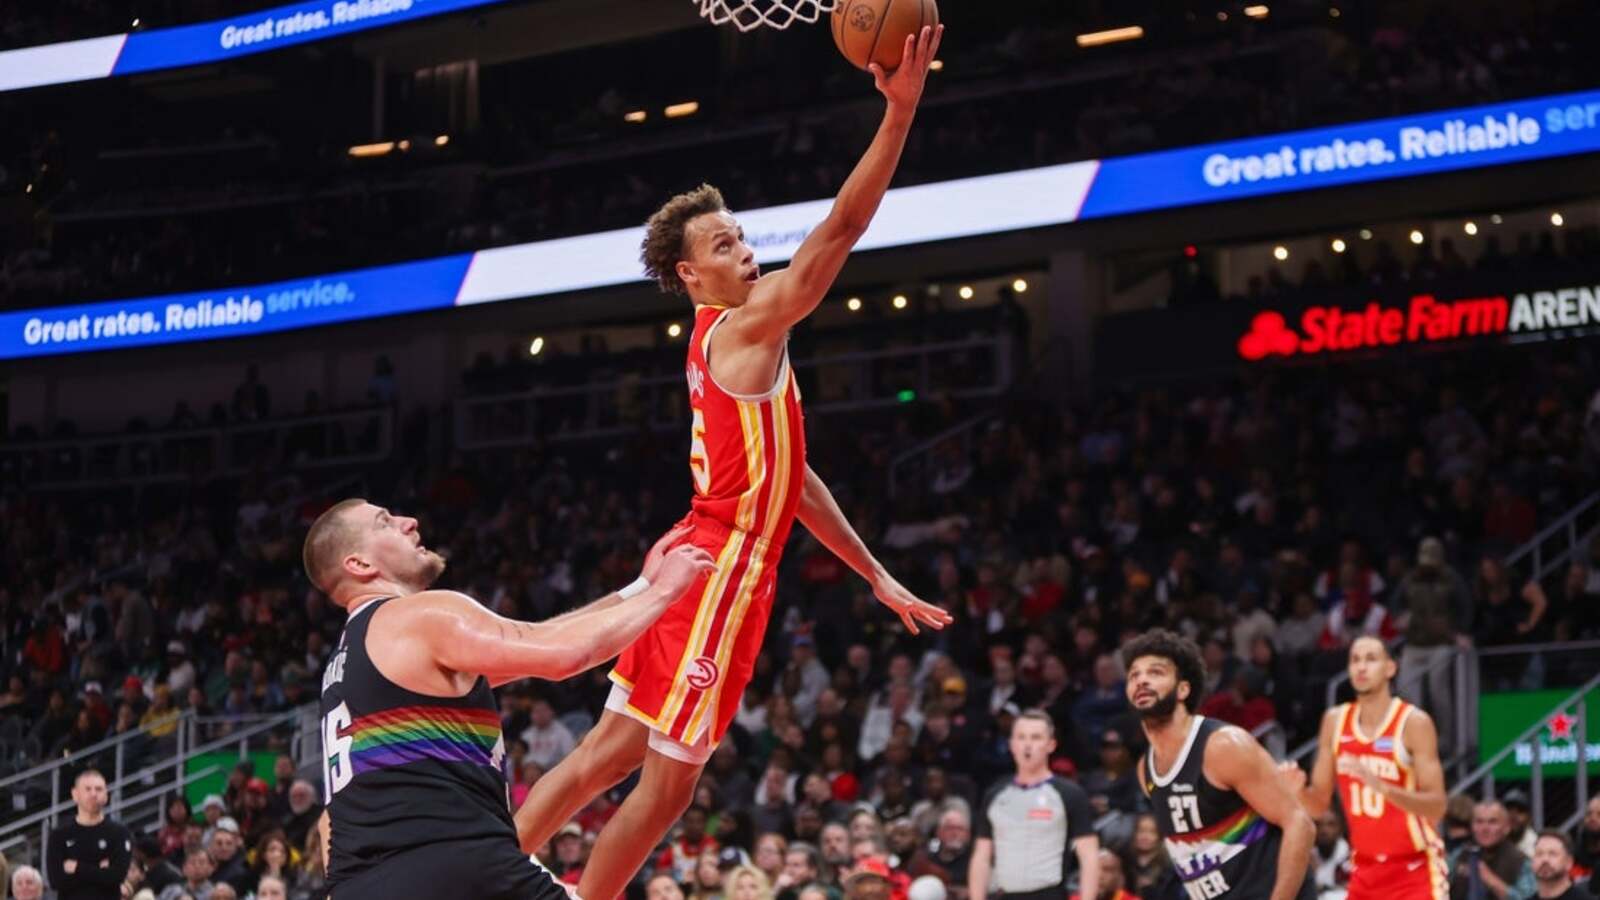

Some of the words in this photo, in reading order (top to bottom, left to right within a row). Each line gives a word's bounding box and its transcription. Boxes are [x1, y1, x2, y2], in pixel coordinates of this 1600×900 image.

[220, 18, 274, 49] Great
[275, 10, 330, 37] rates.
[1203, 146, 1297, 187] Great
[1300, 138, 1396, 174] rates.
[1399, 111, 1541, 160] Reliable
[24, 315, 90, 345] Great
[93, 310, 161, 337] rates.
[165, 295, 264, 331] Reliable
[266, 279, 355, 314] service.
[1301, 303, 1404, 352] State
[1407, 294, 1509, 342] Farm
[1167, 794, 1203, 833] 27
[1350, 781, 1385, 818] 10
